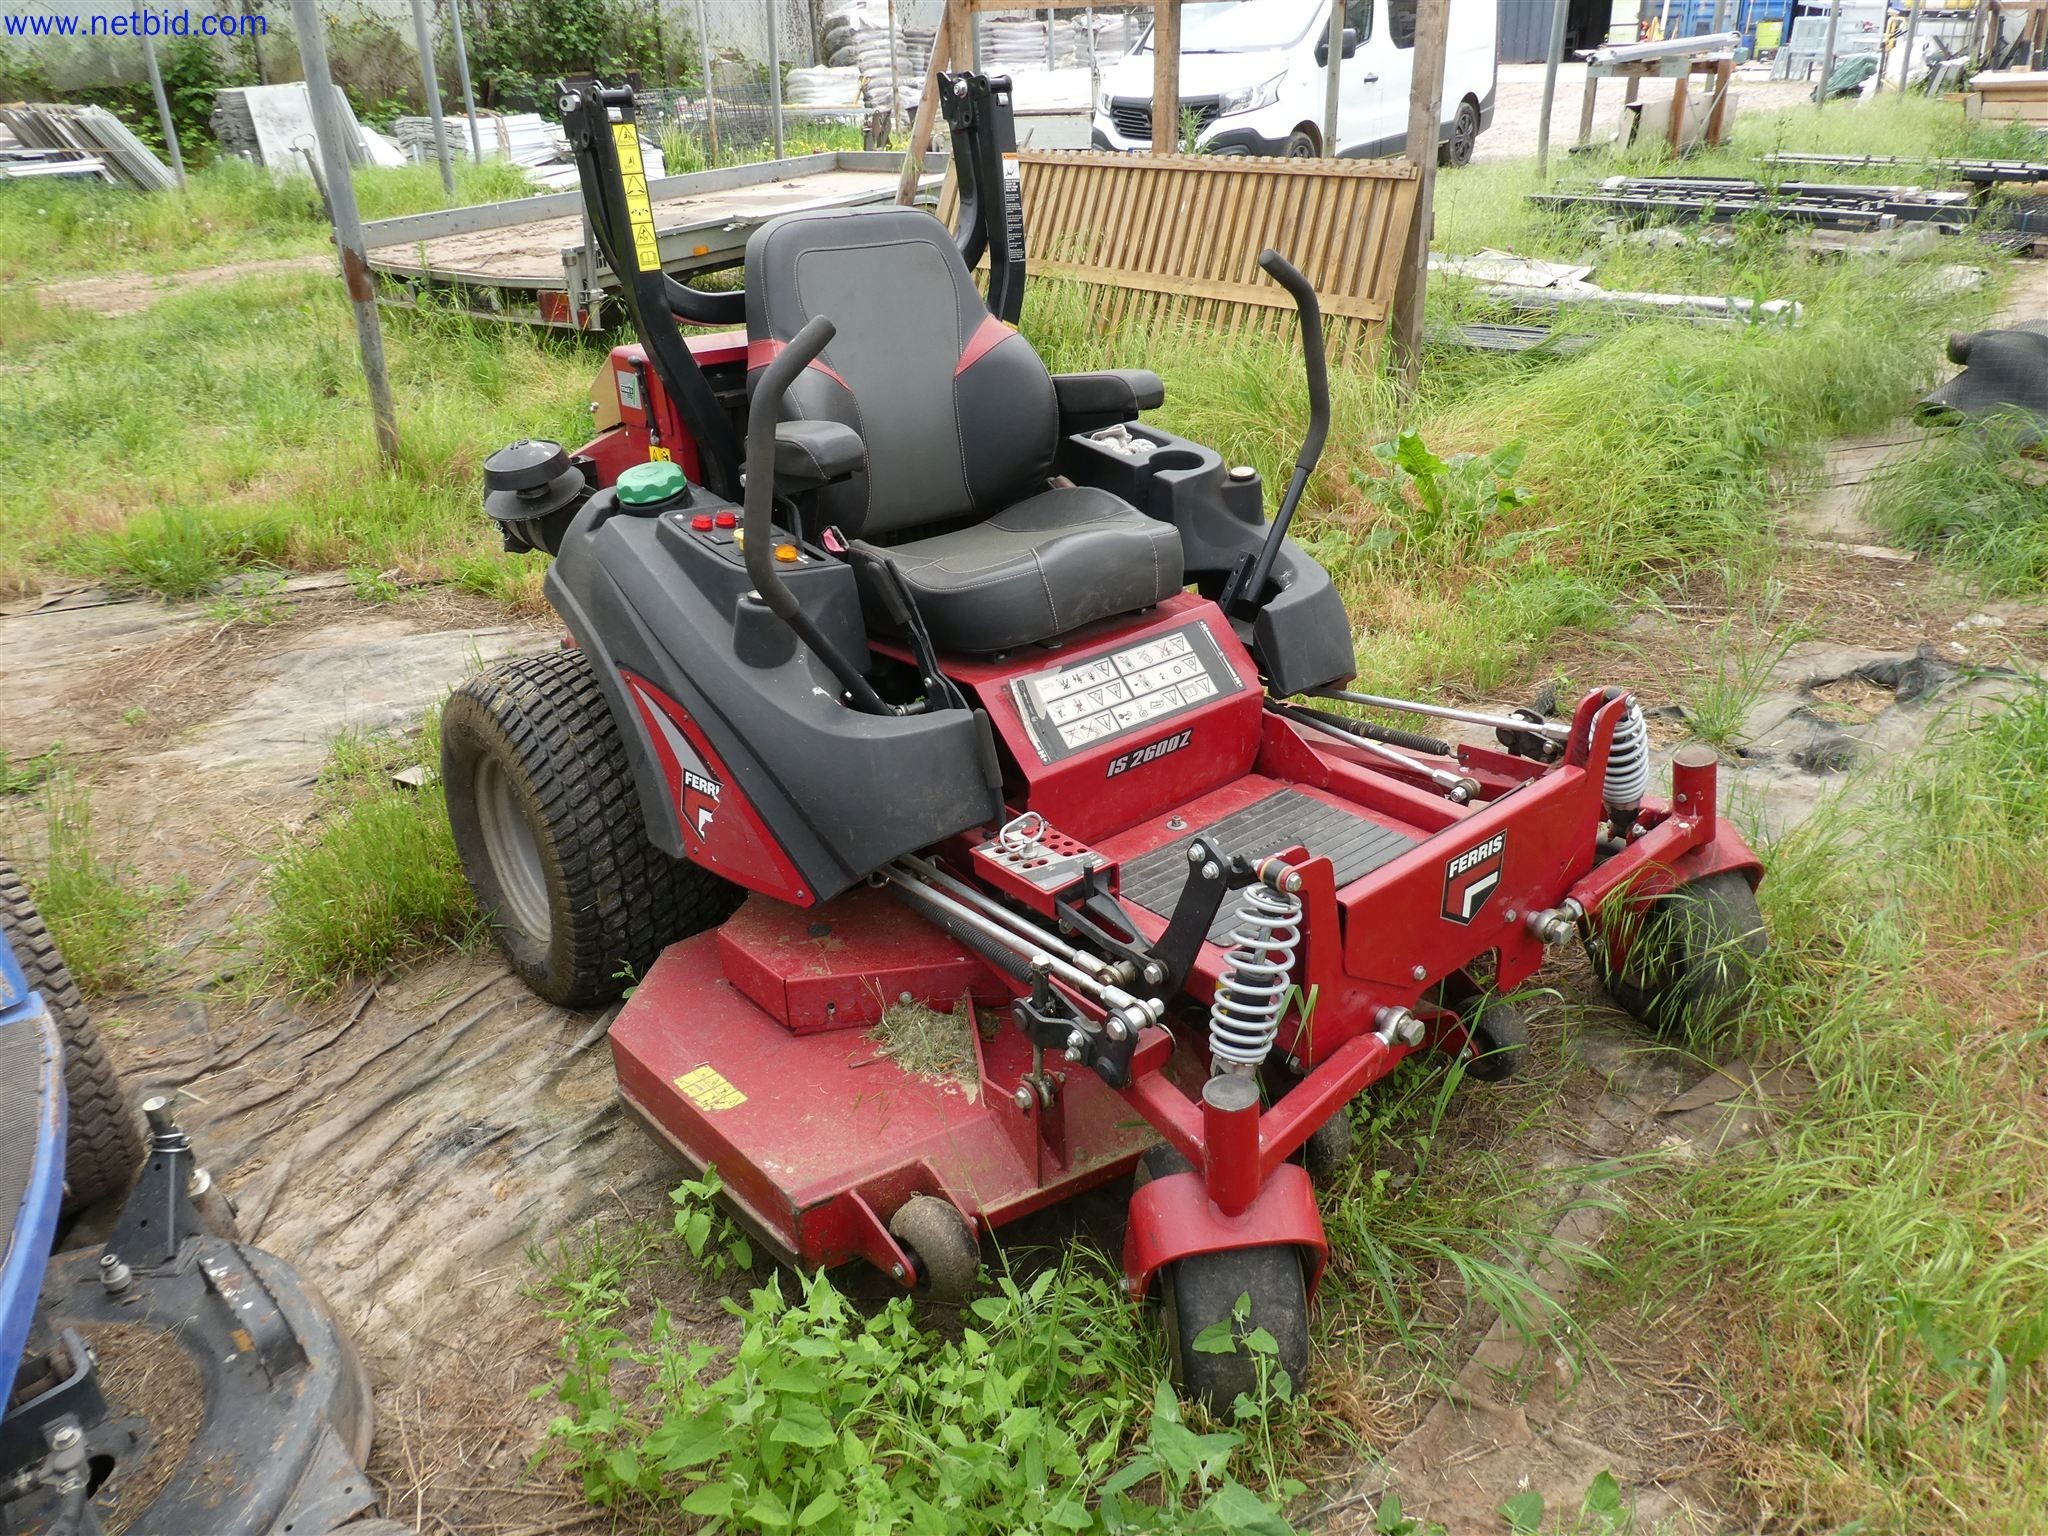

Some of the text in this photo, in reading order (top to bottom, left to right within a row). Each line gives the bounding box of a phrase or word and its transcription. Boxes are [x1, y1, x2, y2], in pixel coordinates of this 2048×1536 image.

[1106, 729, 1192, 778] IS 2600Z
[1448, 834, 1503, 879] FERRIS
